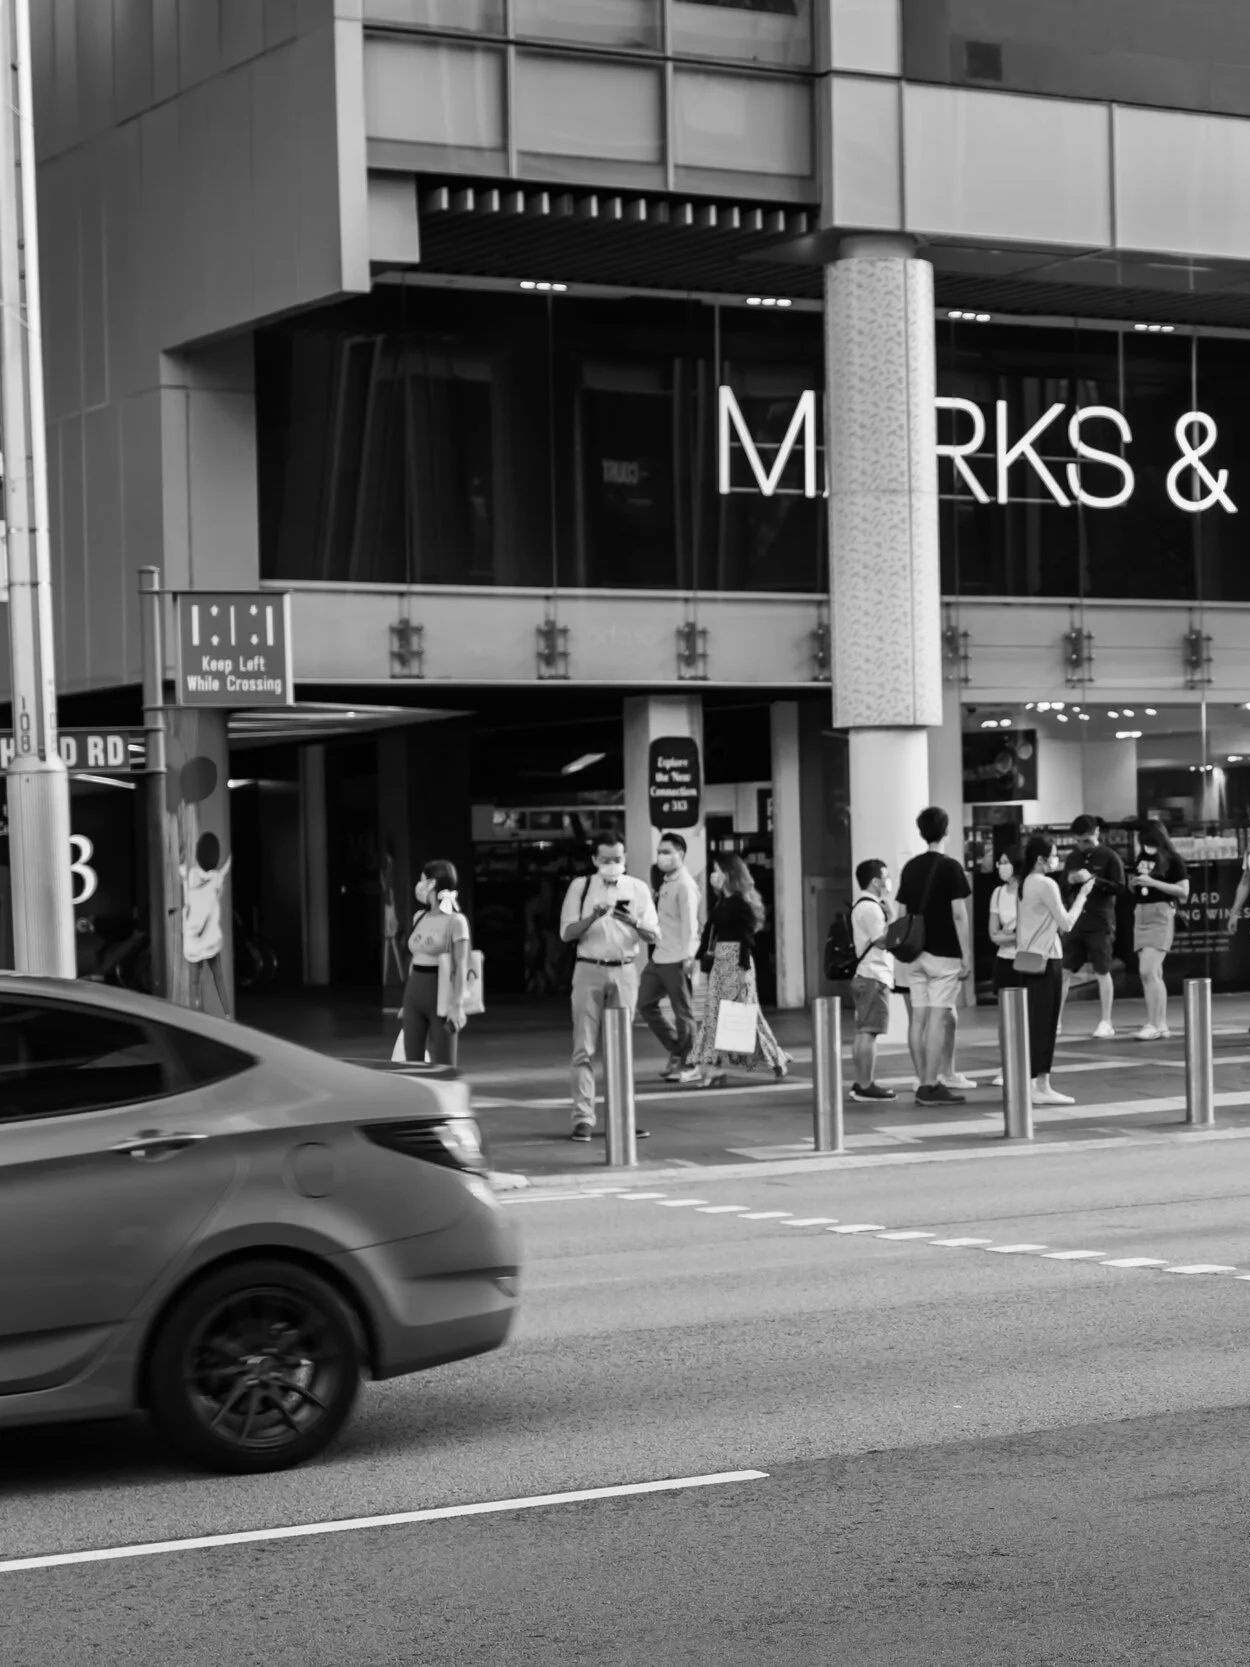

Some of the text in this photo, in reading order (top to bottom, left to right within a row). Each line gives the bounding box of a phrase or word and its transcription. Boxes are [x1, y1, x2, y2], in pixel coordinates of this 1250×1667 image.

[718, 385, 1135, 508] MRKS
[1166, 411, 1239, 513] &
[202, 655, 266, 676] Keep Left
[187, 675, 282, 695] While Crossing
[87, 735, 125, 768] RD
